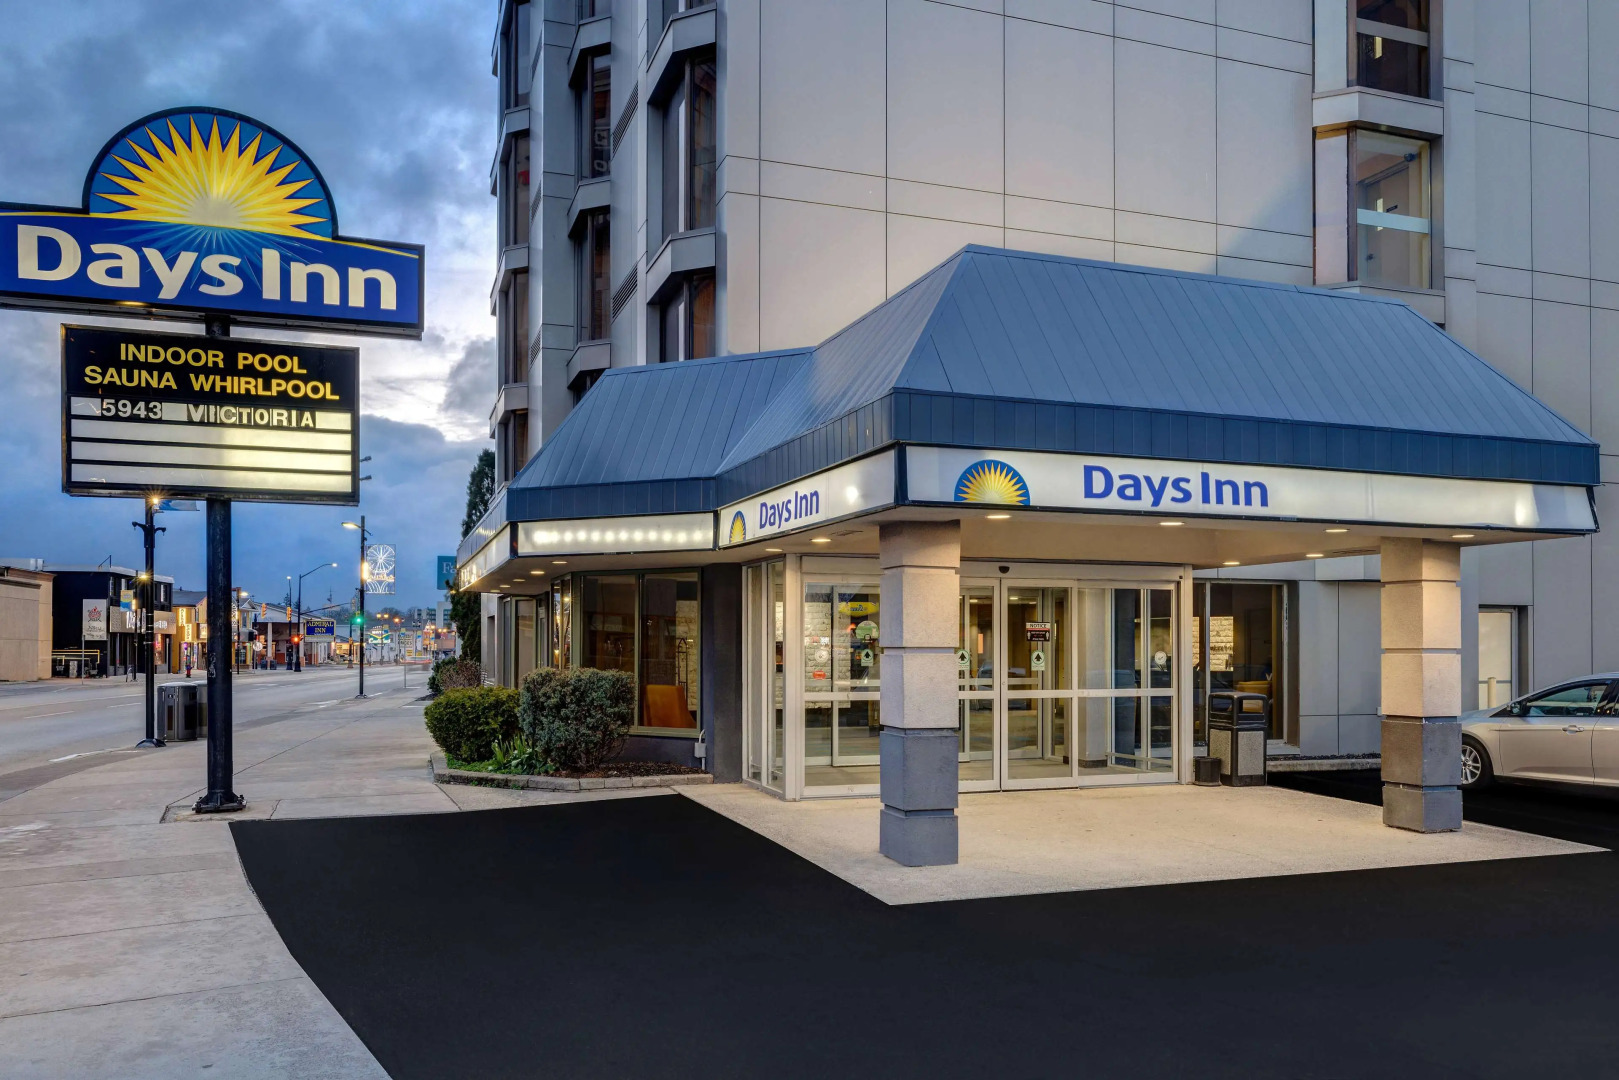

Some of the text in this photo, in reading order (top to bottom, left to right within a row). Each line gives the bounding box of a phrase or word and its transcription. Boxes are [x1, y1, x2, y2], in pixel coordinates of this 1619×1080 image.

[17, 223, 397, 311] Days Inn
[120, 343, 307, 374] INDOOR POOL
[84, 365, 340, 400] SAUNA WHIRLPOOL
[101, 398, 315, 428] 5943 VICTORIA
[1083, 464, 1269, 507] Days Inn
[759, 490, 820, 530] Days Inn
